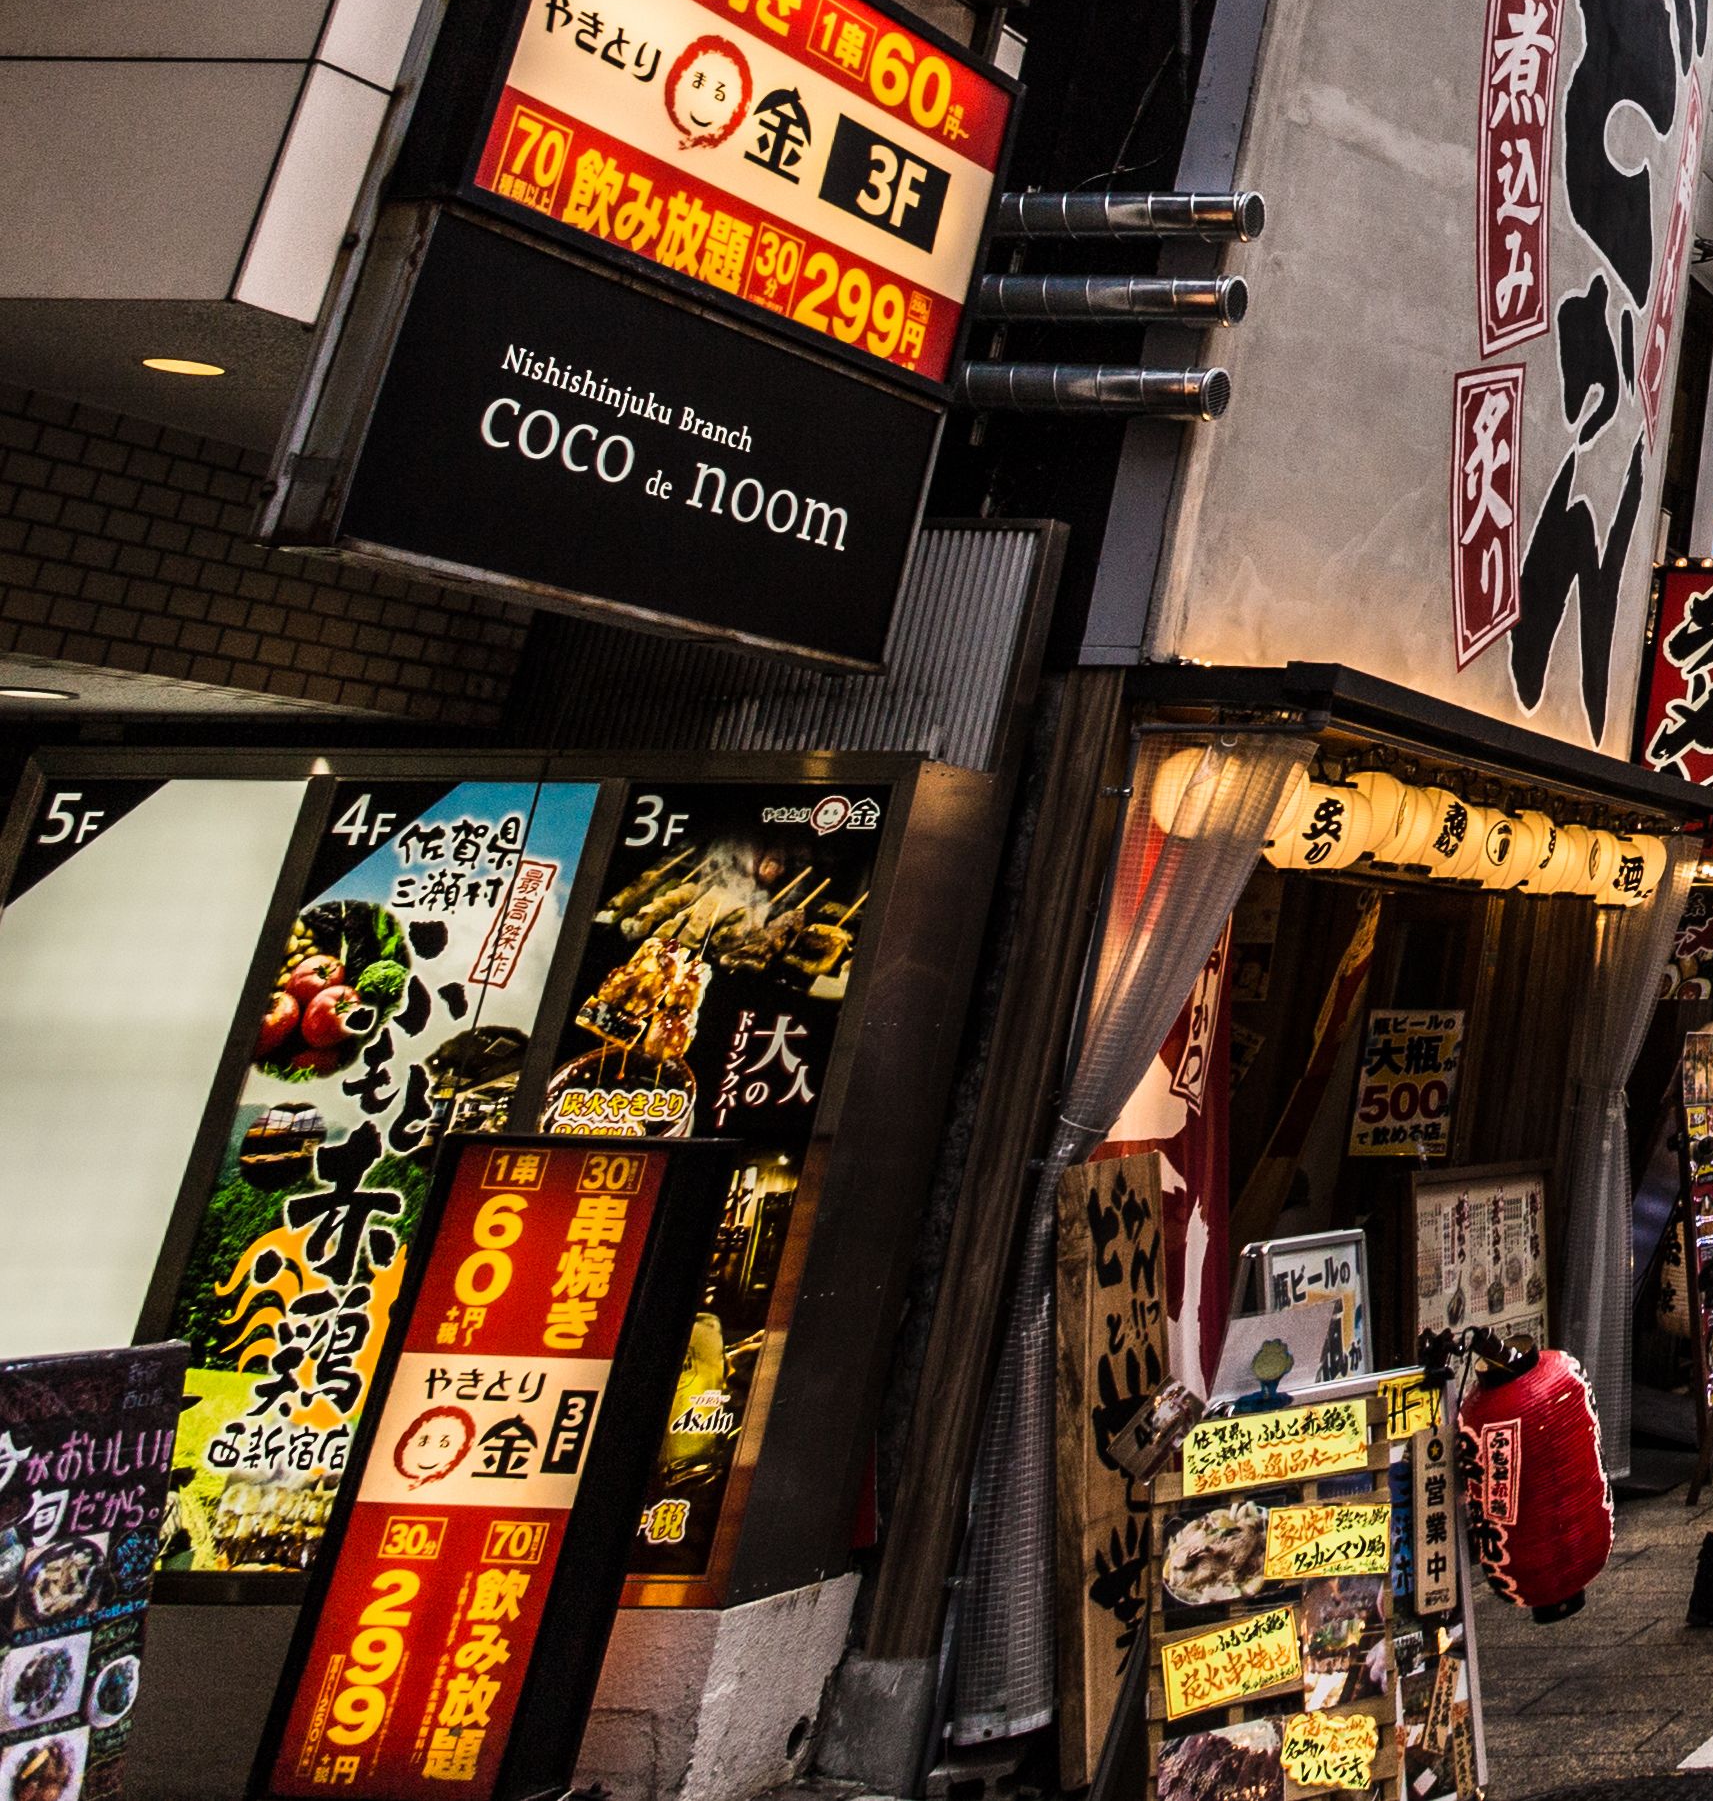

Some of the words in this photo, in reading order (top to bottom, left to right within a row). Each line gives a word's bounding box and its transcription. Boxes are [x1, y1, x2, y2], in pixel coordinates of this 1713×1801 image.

[819, 9, 868, 69] 1串
[869, 37, 953, 133] 60
[690, 68, 728, 105] まる
[743, 86, 814, 182] 金
[867, 144, 930, 228] 3F
[1490, 2, 1556, 322] 煮込み
[512, 114, 563, 186] 70
[561, 146, 752, 295] 飲み放題
[793, 251, 906, 359] 299
[898, 313, 926, 362] 円
[500, 345, 674, 428] Nishishinjuku
[679, 406, 754, 454] Branch
[480, 398, 638, 485] coco
[644, 468, 674, 502] de
[685, 461, 850, 553] noom
[1458, 389, 1520, 622] 炙り
[38, 792, 106, 845] 5F
[330, 794, 398, 847] 4F
[399, 815, 524, 870] 佐賀県
[625, 795, 689, 846] 3F
[762, 807, 811, 826] やきとり
[846, 797, 881, 830] 金
[1301, 797, 1346, 866] 炙り
[392, 870, 505, 915] 三瀬村
[479, 869, 545, 979] 最高傑作
[1373, 1016, 1457, 1038] 瓶ビールの
[712, 1010, 757, 1129] ドリンクバー
[1365, 1036, 1458, 1077] 大瓶が
[559, 1089, 689, 1121] 炭火やきとり
[492, 1153, 542, 1188] 1串
[582, 1155, 632, 1191] 30
[453, 1196, 525, 1308] 60
[544, 1197, 627, 1350] 串焼き
[1272, 1257, 1351, 1309] 瓶ビールの
[422, 1366, 547, 1403] やきとり
[207, 1425, 349, 1474] 西新宿店
[415, 1431, 451, 1452] まる
[471, 1414, 540, 1480] 金
[551, 1397, 586, 1467] 3F
[669, 1406, 737, 1436] Asahi
[18, 1485, 160, 1547] 旬だから。
[384, 1523, 437, 1556] 30分
[491, 1524, 533, 1557] 70
[1424, 1472, 1448, 1584] 営業中
[326, 1568, 421, 1746] 299
[421, 1568, 531, 1782] 飲み放題
